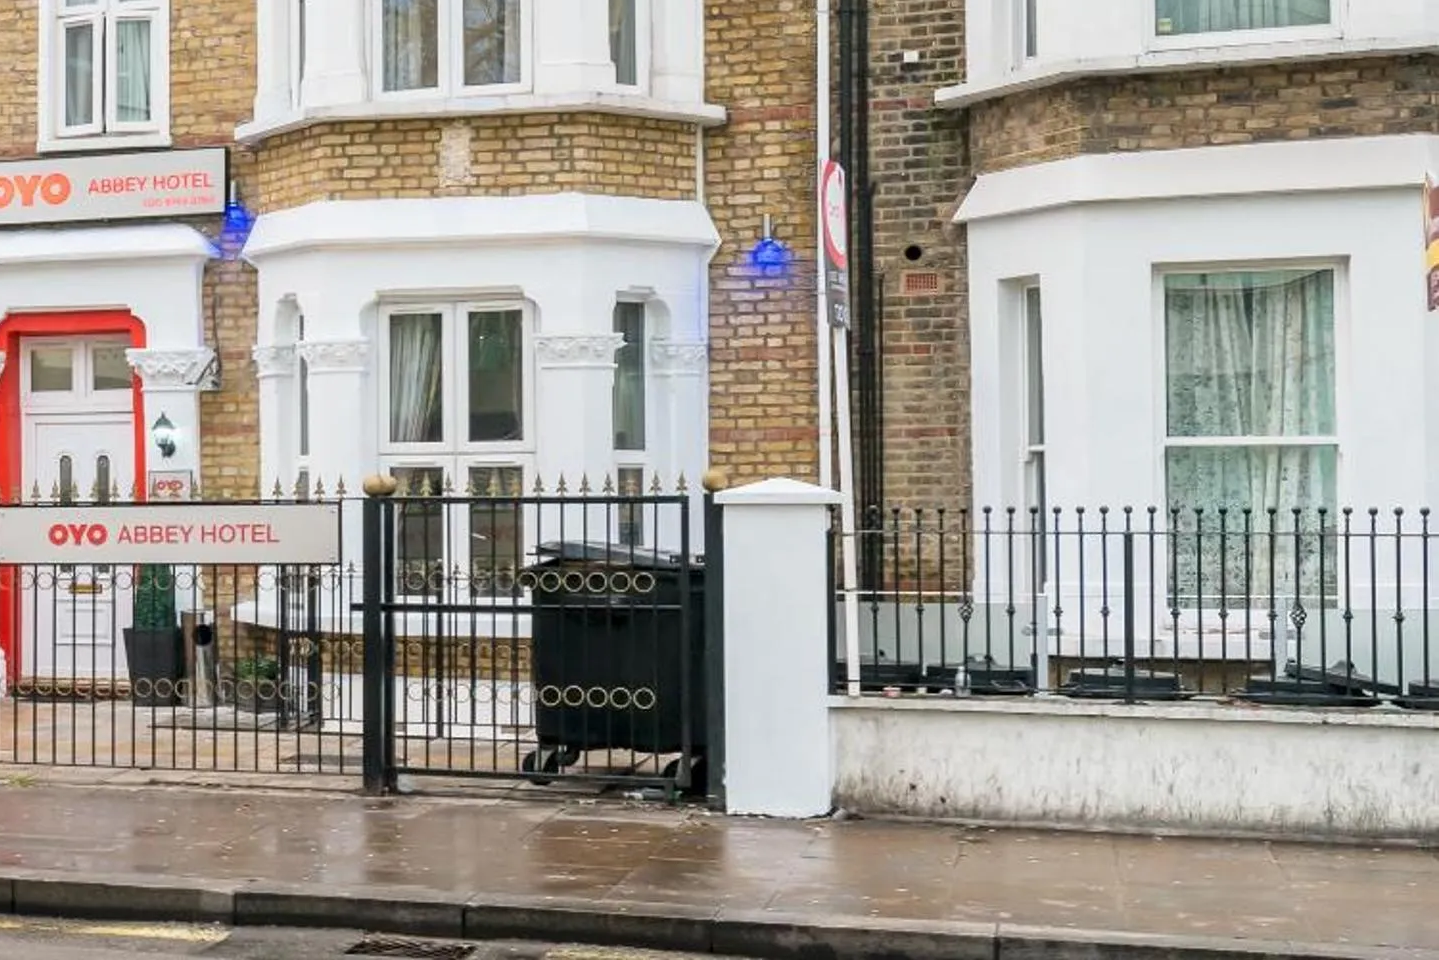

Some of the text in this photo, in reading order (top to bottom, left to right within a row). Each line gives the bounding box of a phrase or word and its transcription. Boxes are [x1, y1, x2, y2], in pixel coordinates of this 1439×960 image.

[88, 176, 147, 194] ABBEY
[153, 173, 214, 191] HOTEL
[48, 523, 280, 546] OYO ABBEY HOTEL
